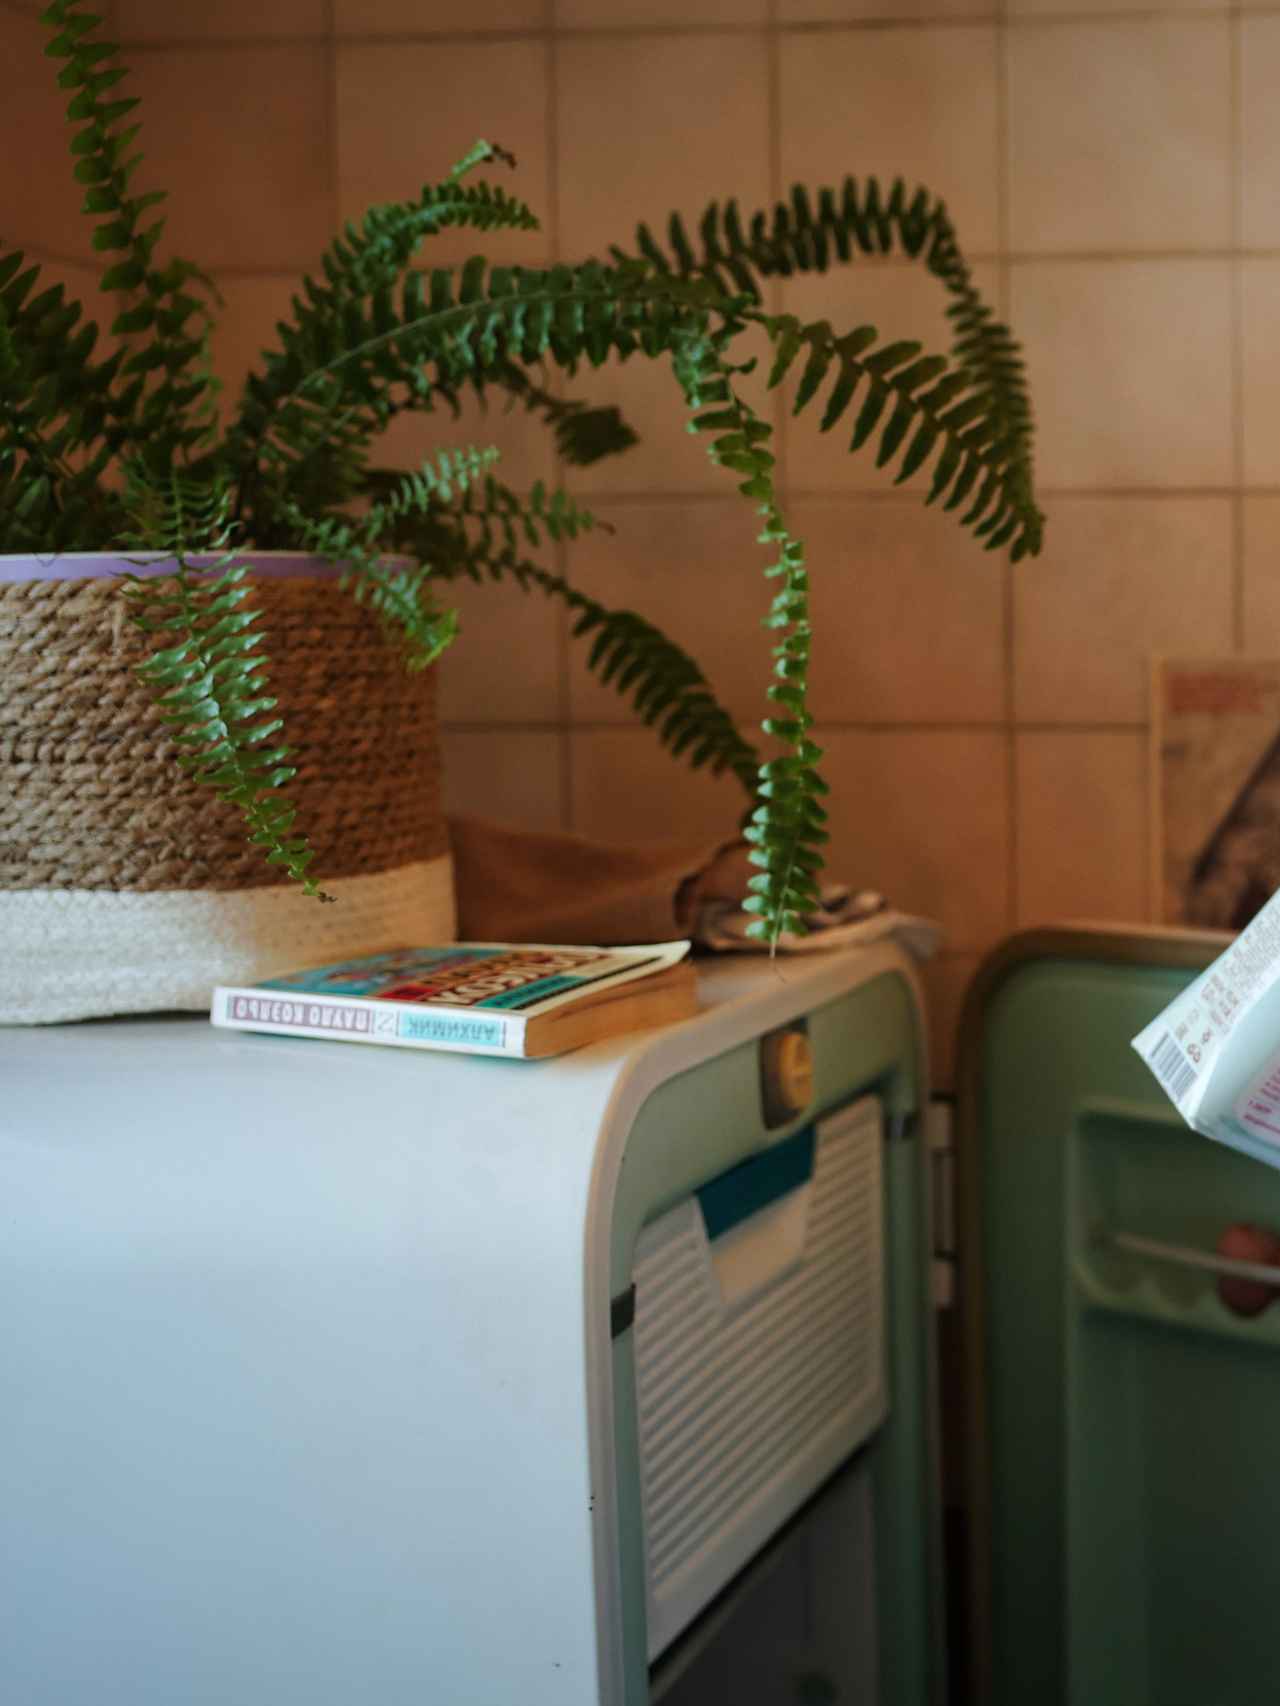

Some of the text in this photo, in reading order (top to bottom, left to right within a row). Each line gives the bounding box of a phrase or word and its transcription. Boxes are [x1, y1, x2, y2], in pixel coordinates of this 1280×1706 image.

[236, 998, 368, 1030] ПАУЛО КОЭЛЬО
[408, 1016, 495, 1041] АЛХИМИК
